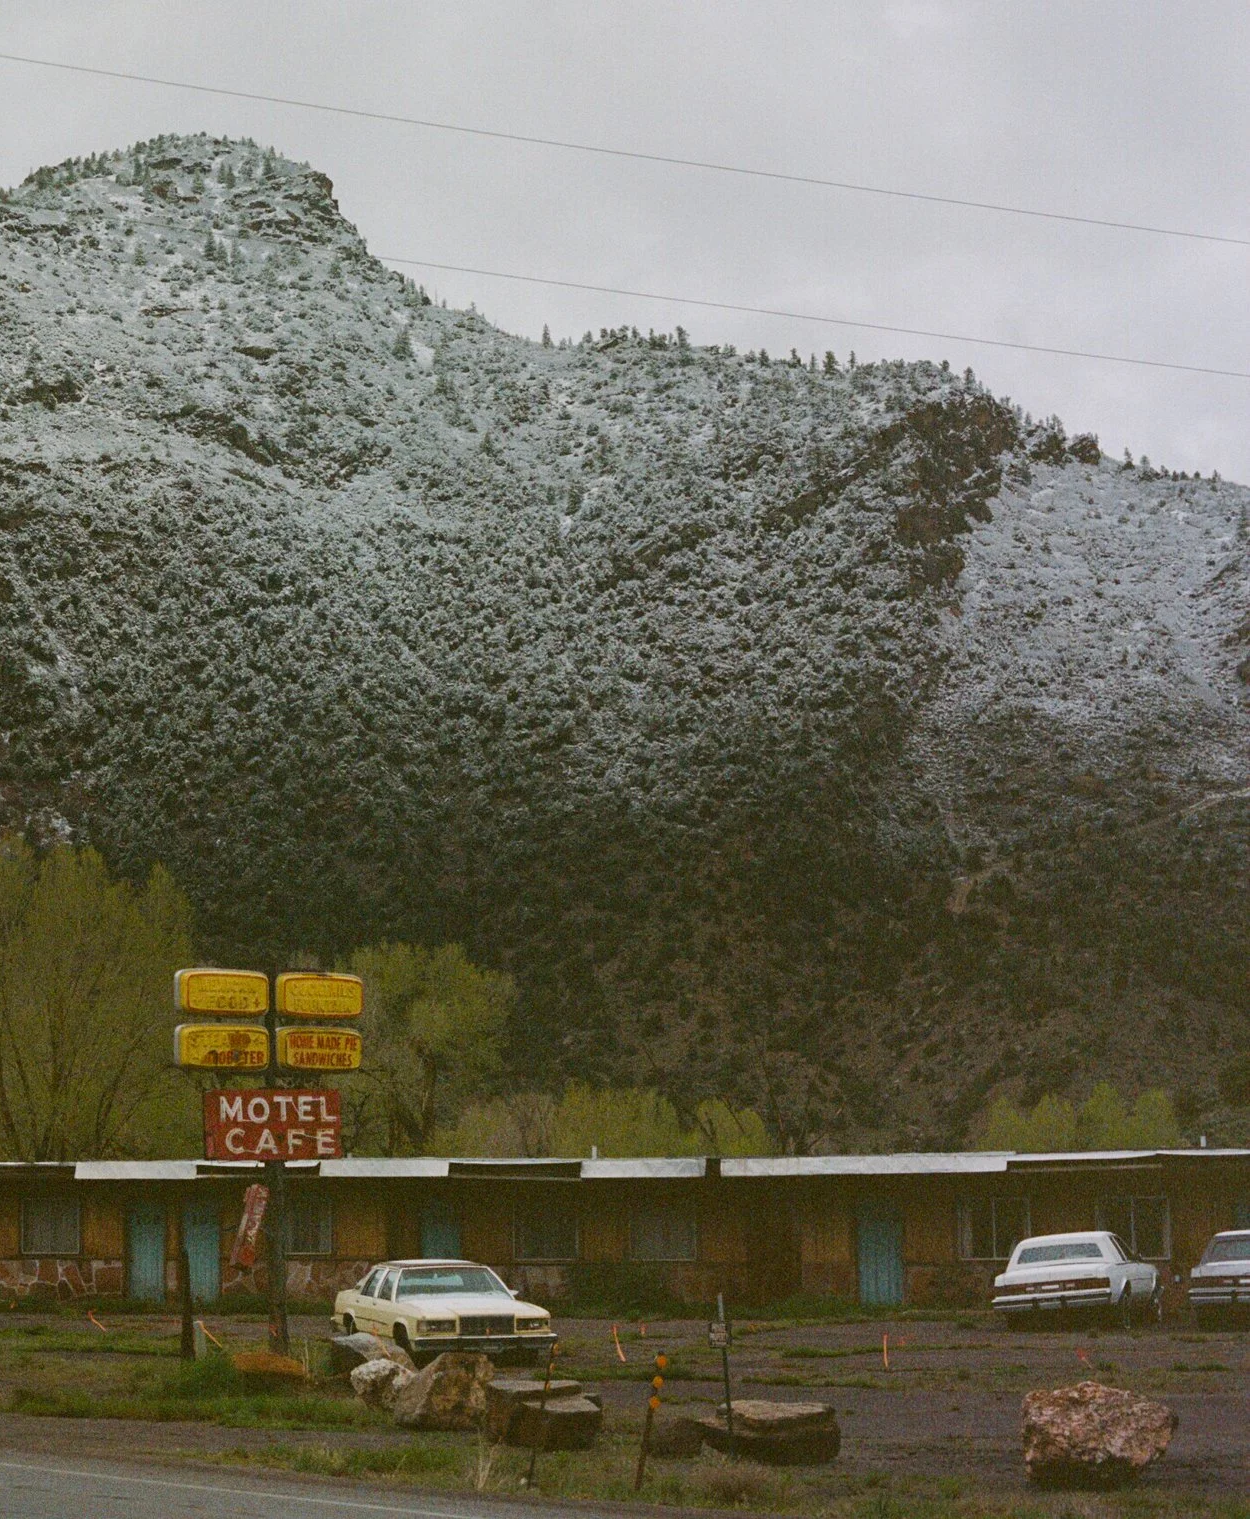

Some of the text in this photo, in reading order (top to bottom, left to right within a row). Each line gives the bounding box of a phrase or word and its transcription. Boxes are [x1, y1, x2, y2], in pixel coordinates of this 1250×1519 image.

[289, 1035, 358, 1051] HOME MADE PIE
[213, 1049, 265, 1065] OBTER
[293, 1051, 353, 1067] SANDWICHES
[219, 1095, 337, 1123] MOTEL
[225, 1128, 336, 1155] CAFE
